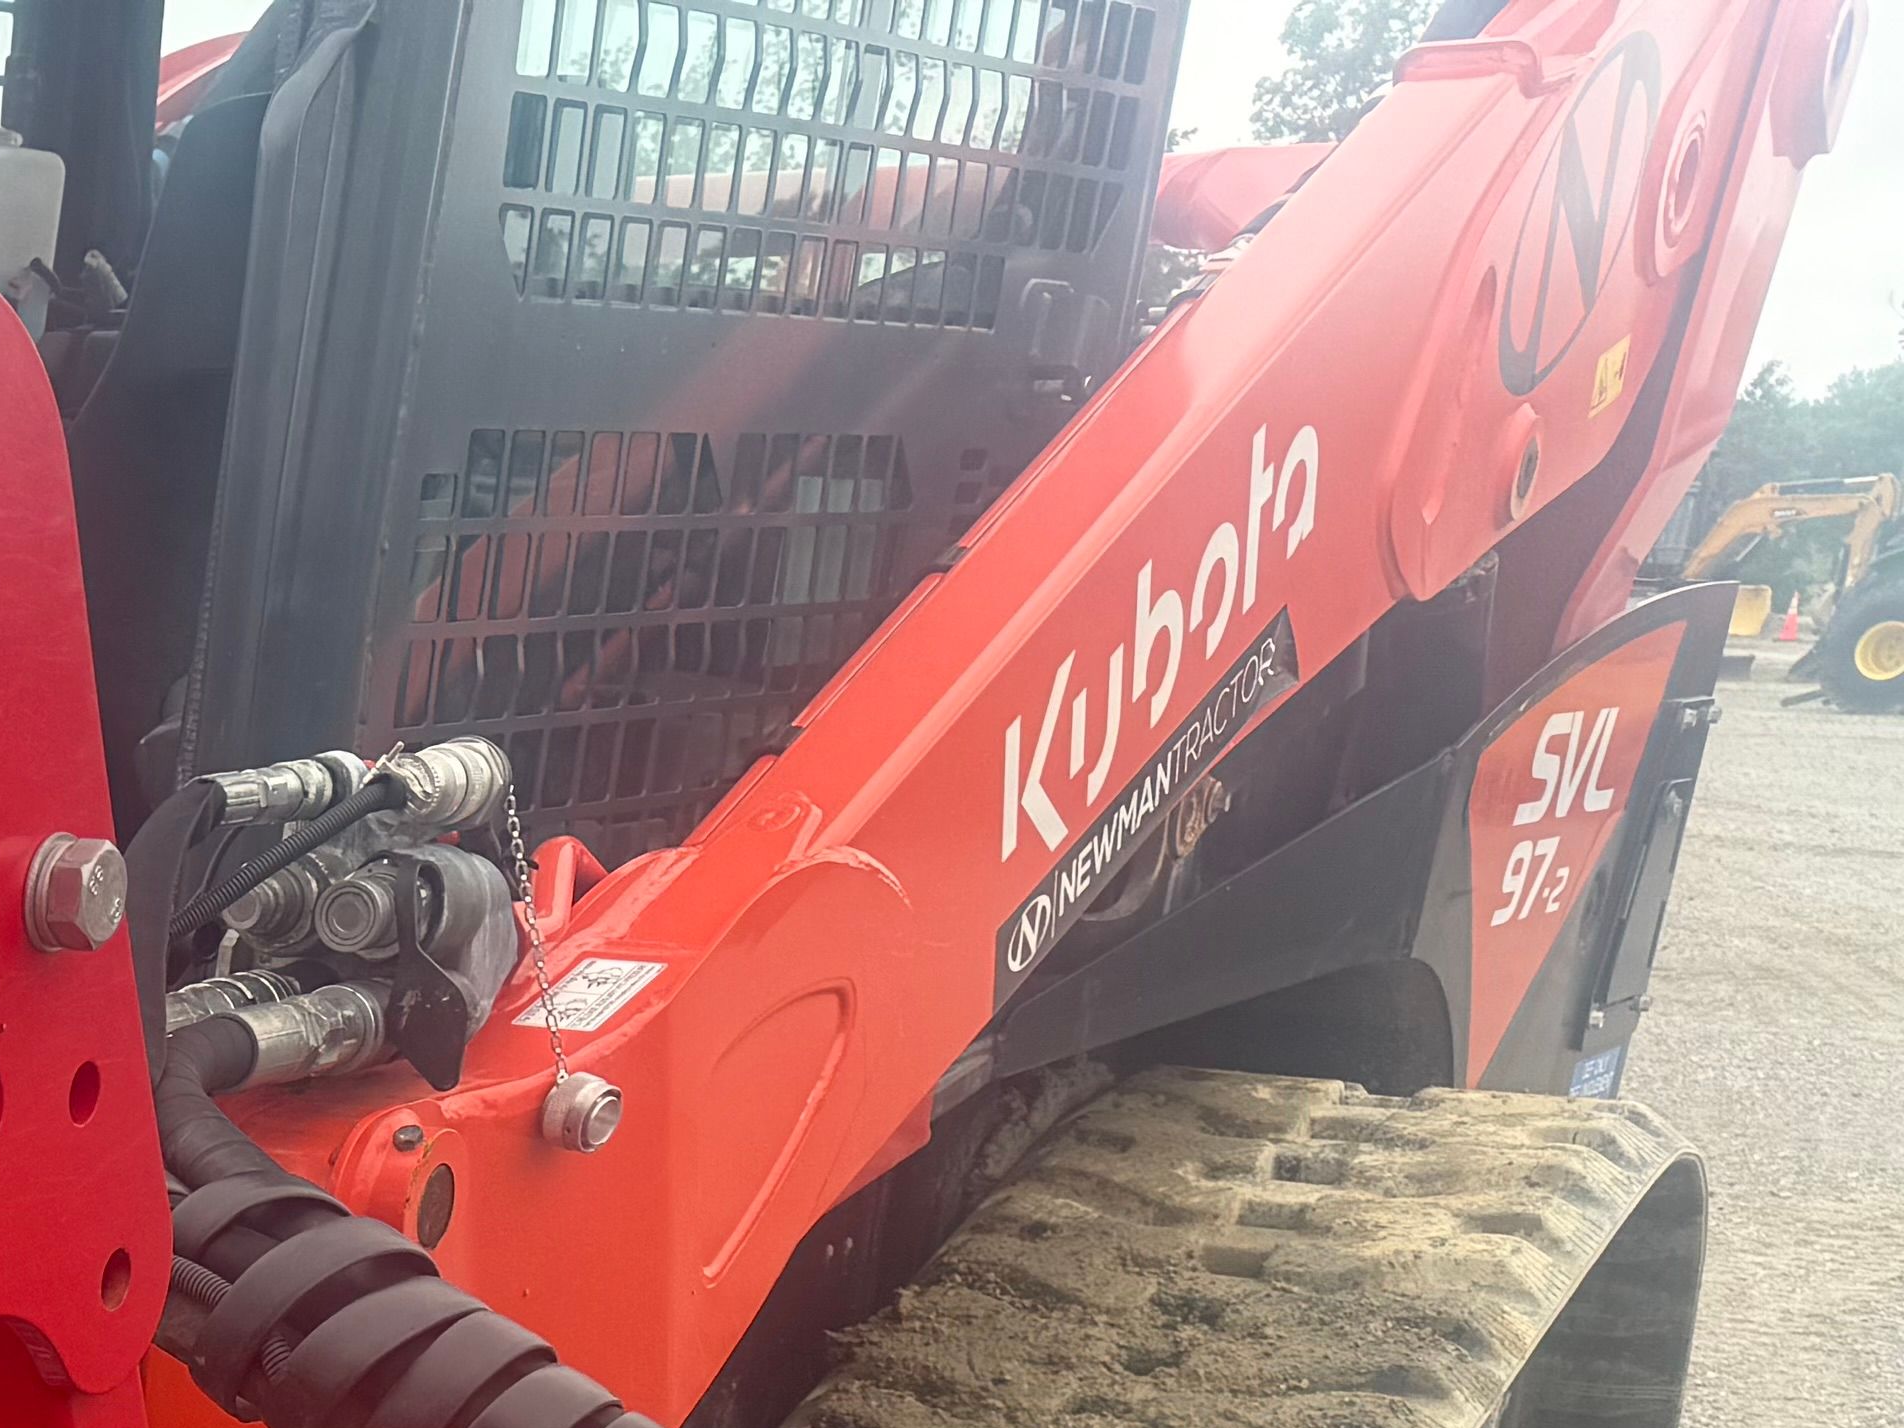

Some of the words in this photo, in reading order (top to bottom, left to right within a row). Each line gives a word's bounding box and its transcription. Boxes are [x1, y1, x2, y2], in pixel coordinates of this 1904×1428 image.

[1000, 423, 1320, 863] Kubota
[1512, 706, 1620, 826] SVL
[1490, 836, 1570, 927] 97-2
